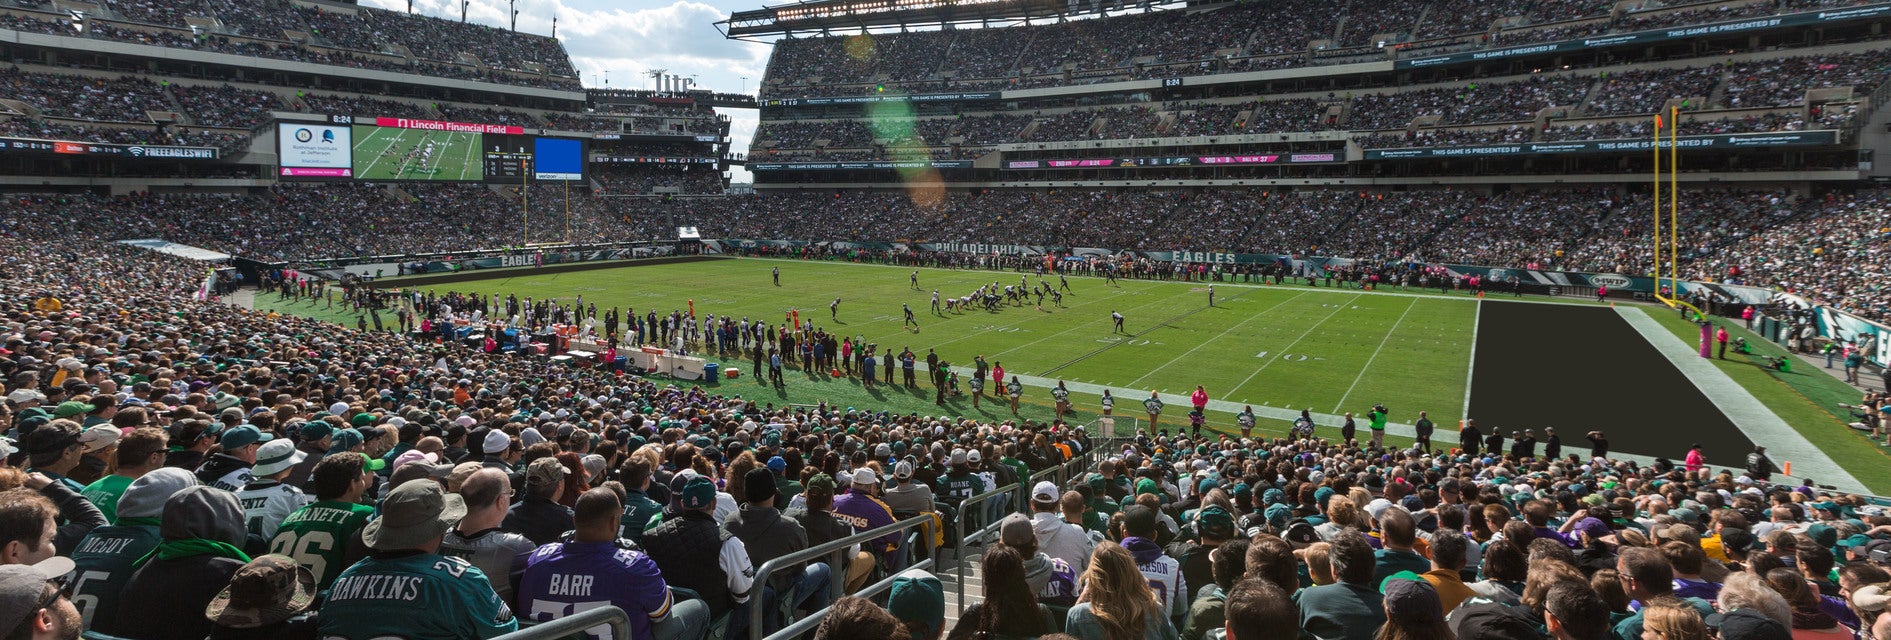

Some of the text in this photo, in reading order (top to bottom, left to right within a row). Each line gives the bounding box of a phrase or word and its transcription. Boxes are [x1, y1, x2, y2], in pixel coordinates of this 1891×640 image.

[1686, 27, 1709, 35] GAME
[1719, 21, 1768, 31] PRESENTED
[1511, 46, 1548, 55] PRESENTED
[333, 115, 351, 123] 6:24
[410, 120, 507, 134] Lincoln Financial Field
[1472, 146, 1510, 154] PRESENTED
[1650, 139, 1700, 147] PRESENTED
[145, 147, 212, 158] FREEEAGLESWIFI
[1173, 251, 1235, 265] EAGLES
[240, 496, 269, 510] ENTZ
[81, 537, 134, 555] McCOY
[1138, 559, 1169, 575] ERSON
[330, 575, 423, 602] DAWKINS
[548, 573, 594, 597] BARR
[72, 570, 111, 630] 5
